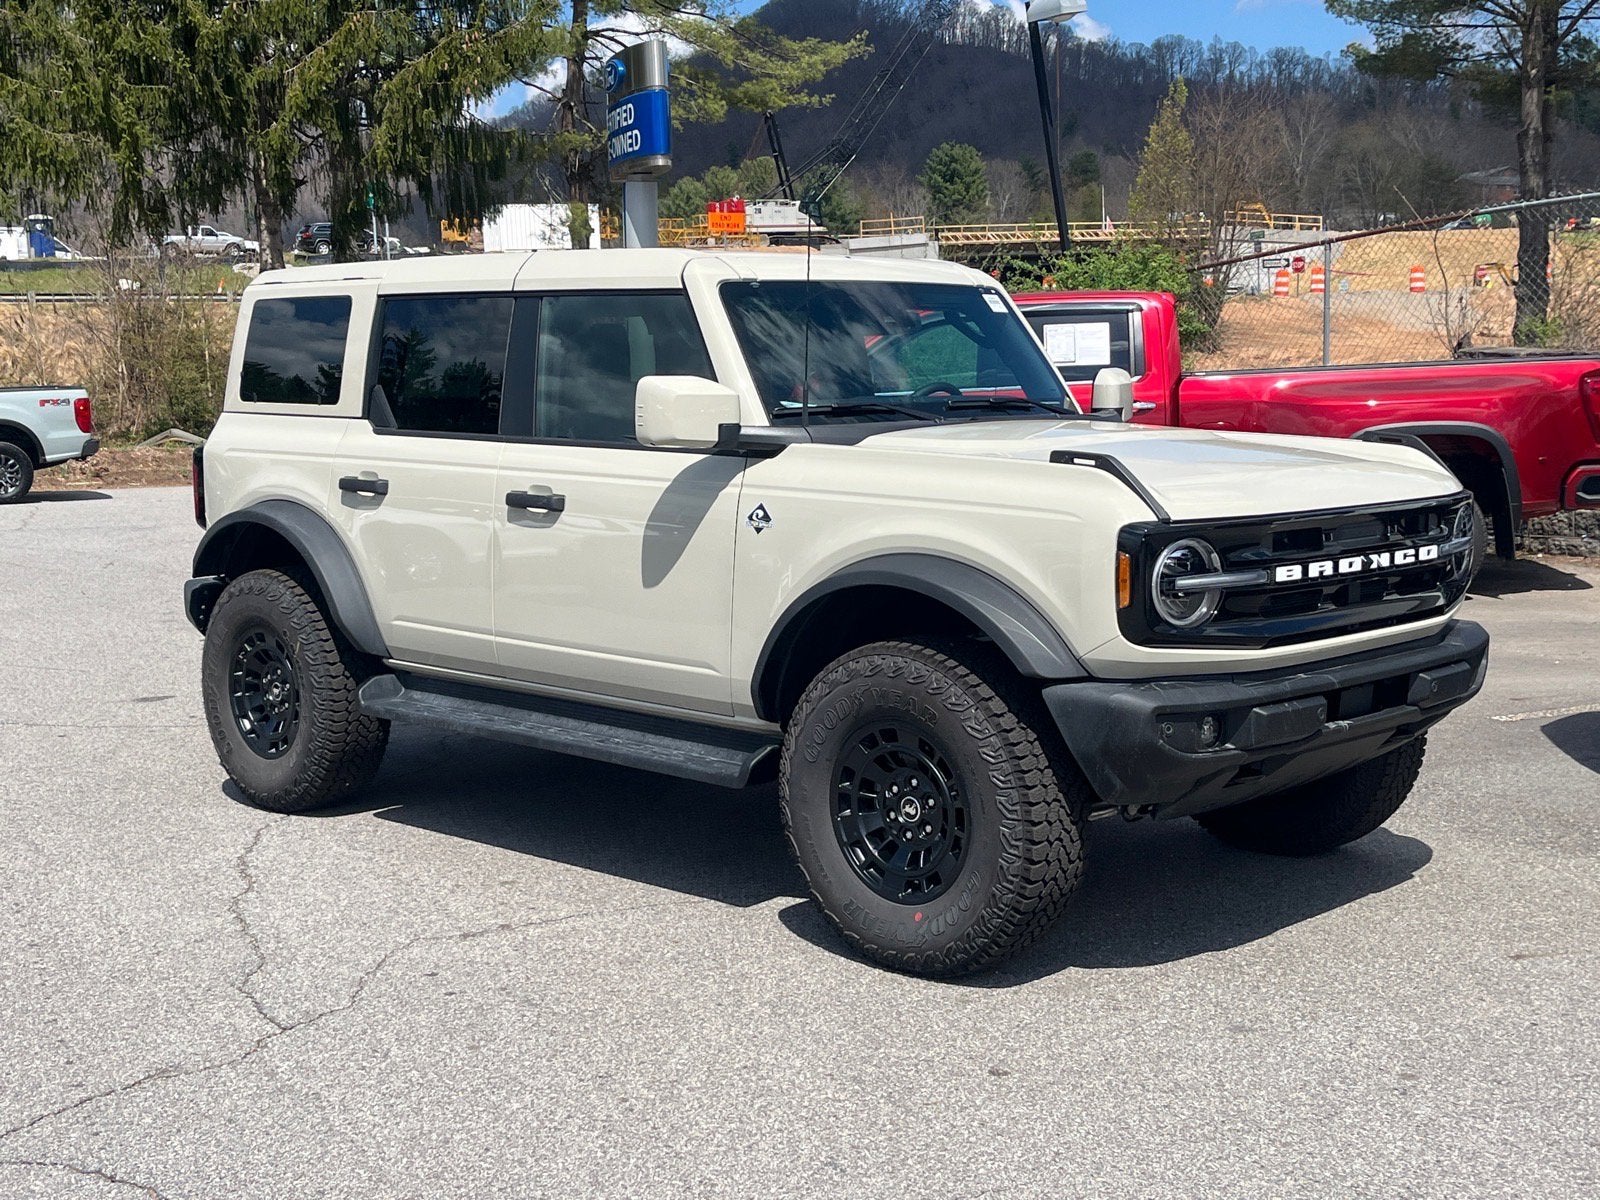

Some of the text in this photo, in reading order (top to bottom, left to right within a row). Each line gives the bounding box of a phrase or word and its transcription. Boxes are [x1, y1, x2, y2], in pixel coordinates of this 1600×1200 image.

[1292, 261, 1304, 269] STOP
[39, 398, 71, 407] FX4
[1275, 544, 1439, 582] BRONCO
